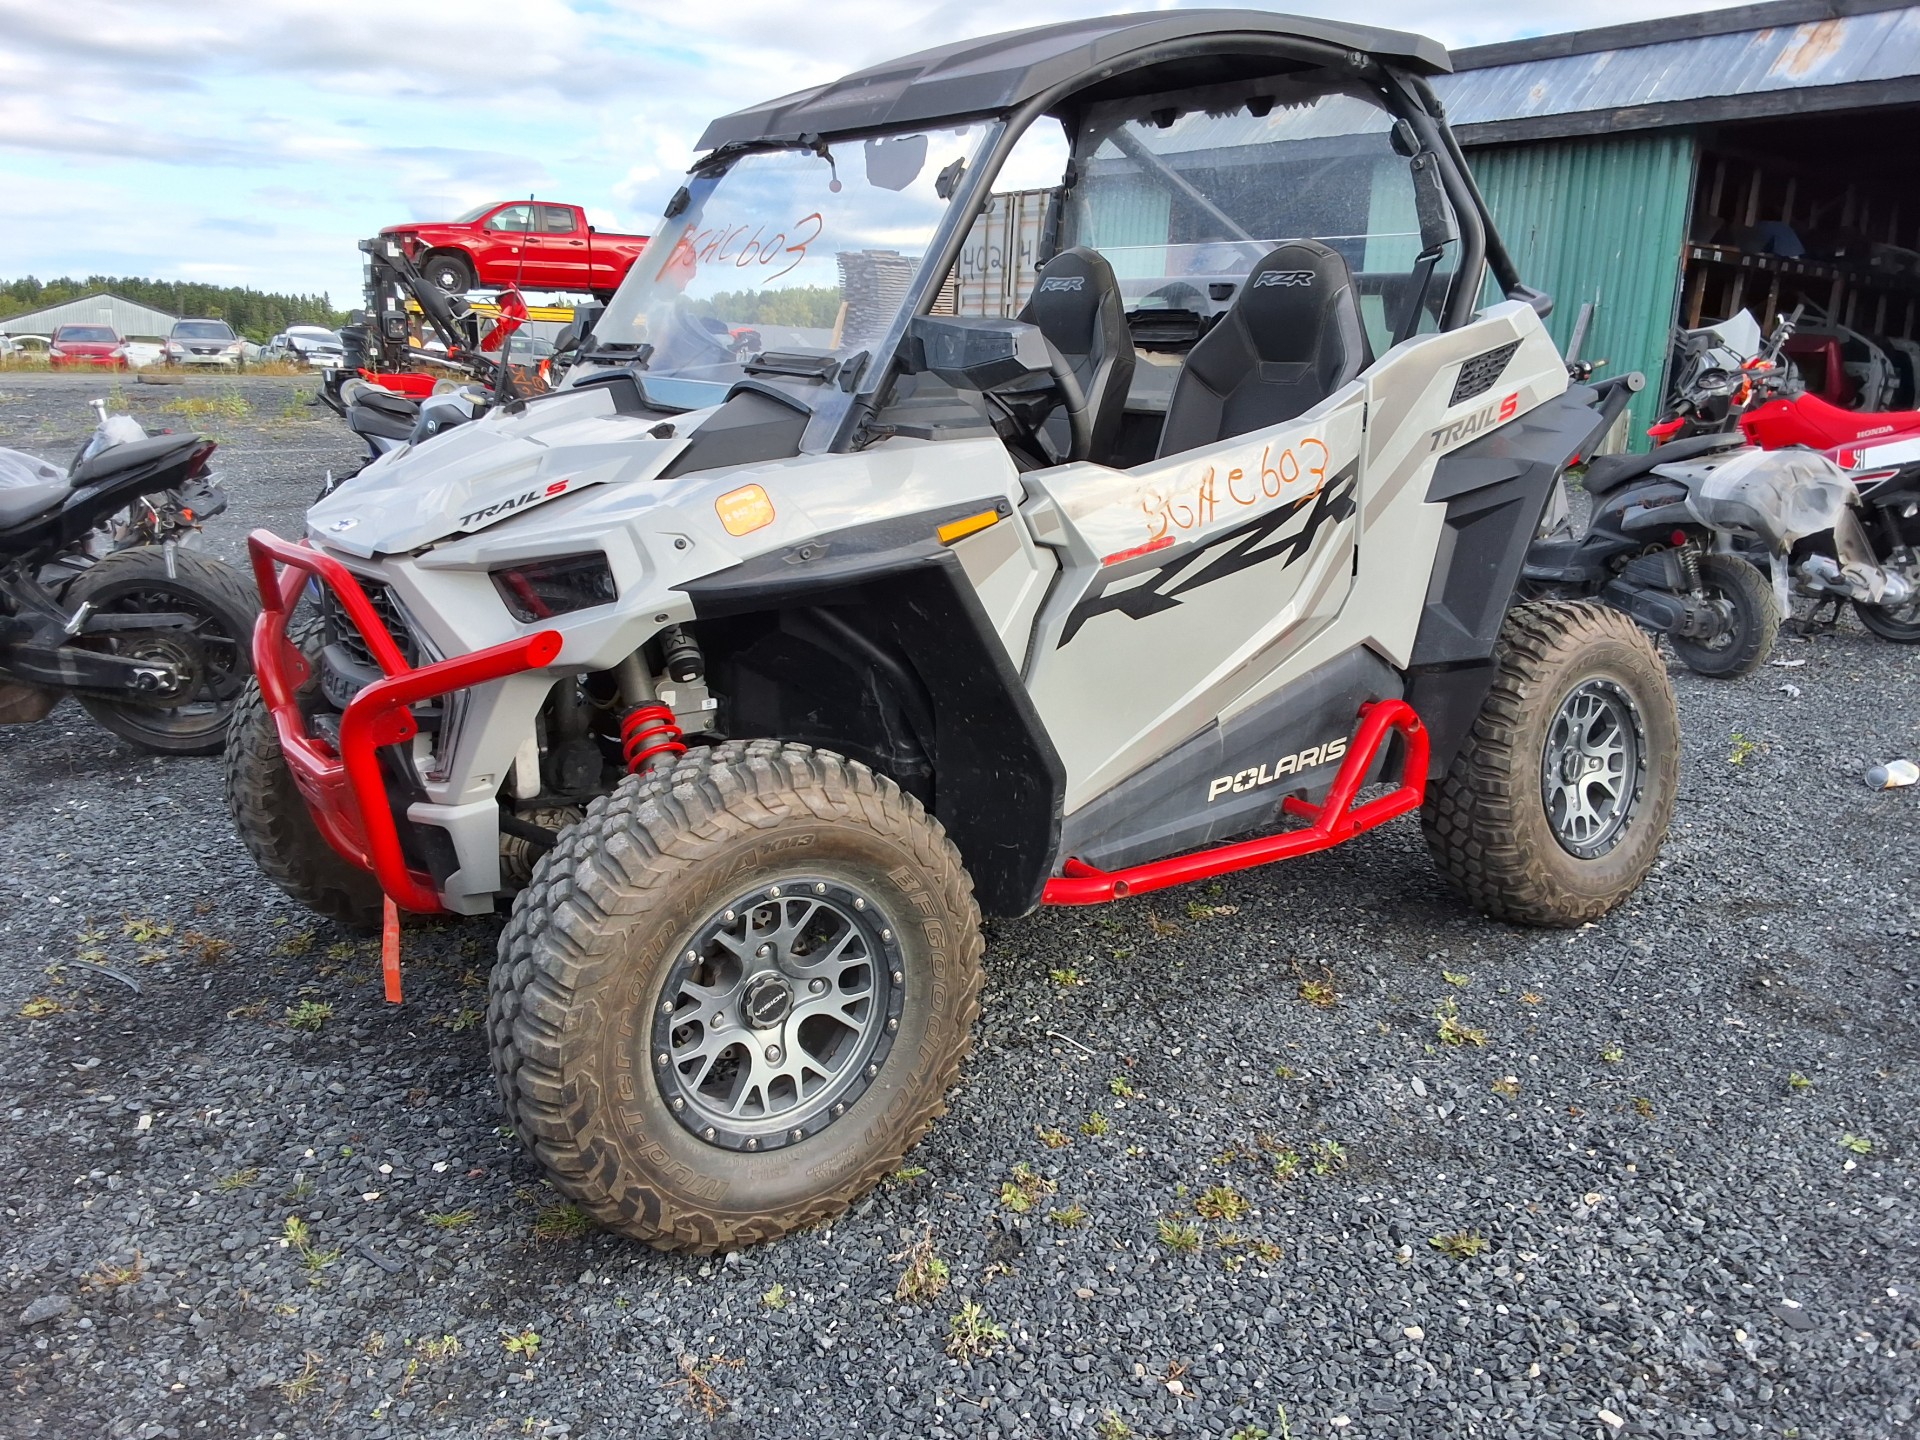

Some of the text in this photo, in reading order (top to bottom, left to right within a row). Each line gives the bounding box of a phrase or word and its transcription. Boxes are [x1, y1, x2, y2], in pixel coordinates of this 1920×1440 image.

[1040, 276, 1085, 292] RZR
[1253, 270, 1316, 289] RZR
[1430, 392, 1518, 452] TRAIL S
[1856, 425, 1894, 439] HONDA
[459, 479, 569, 527] TRAIL S
[1056, 454, 1359, 650] RZR
[1208, 736, 1348, 802] POLARIS
[760, 833, 816, 854] KM3
[755, 991, 787, 1016] VISION
